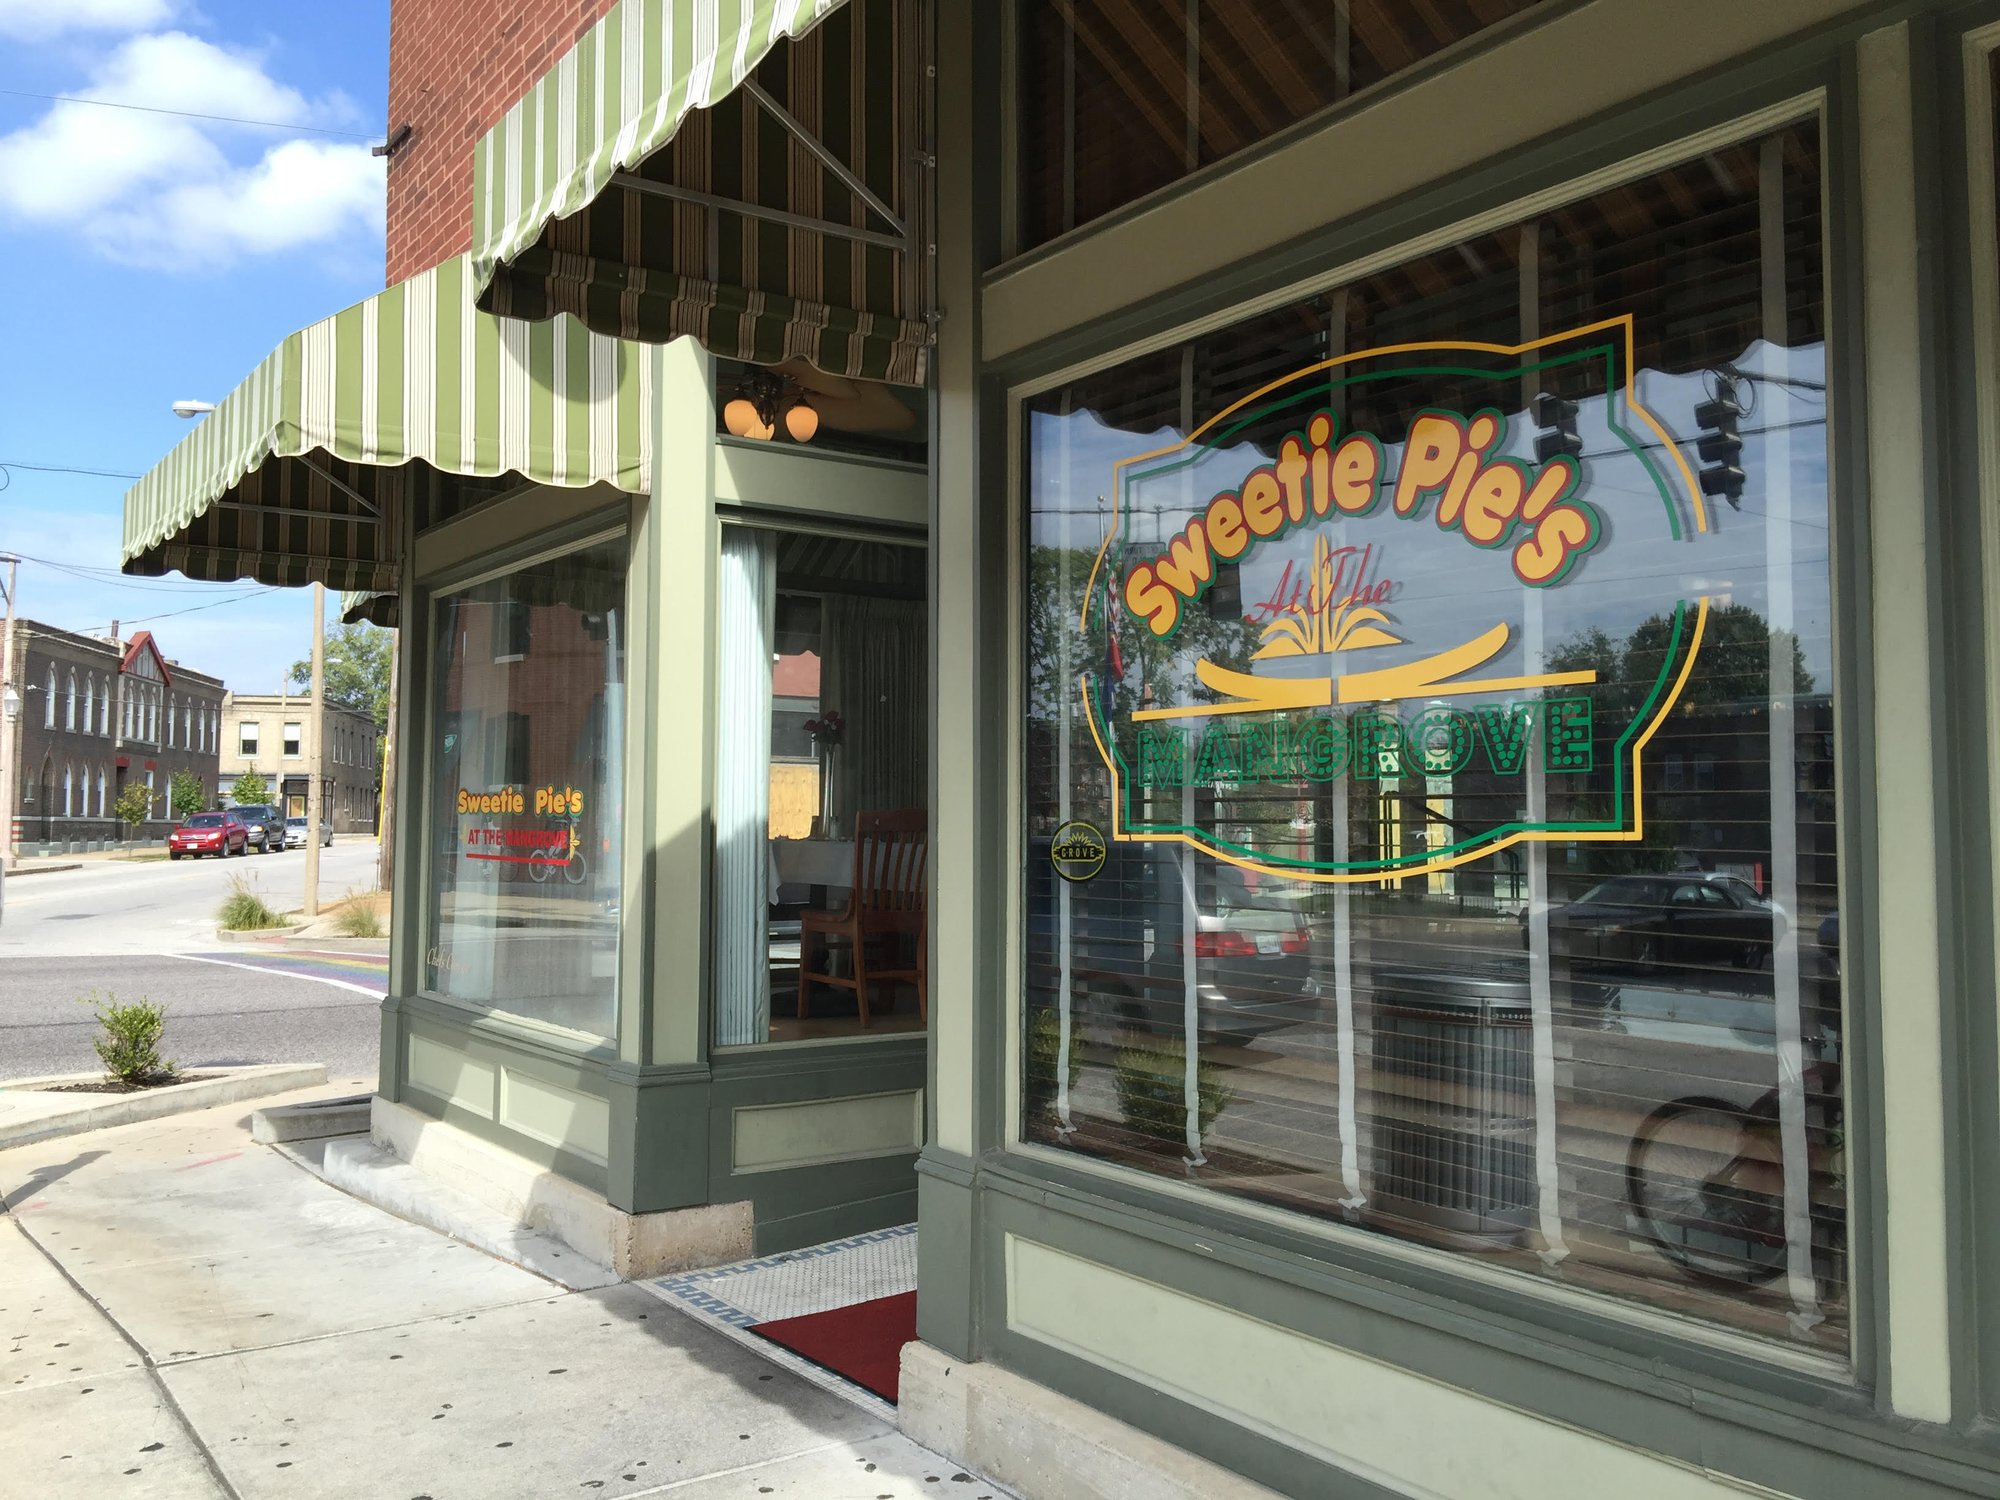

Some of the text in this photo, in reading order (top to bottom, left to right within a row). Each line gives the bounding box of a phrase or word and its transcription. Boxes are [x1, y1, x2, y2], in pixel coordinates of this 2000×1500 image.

[1124, 407, 1601, 640] Sweetie Pie's
[1243, 543, 1391, 625] At The
[1137, 696, 1593, 788] MANGROVE
[457, 784, 584, 816] Sweetie Pie's
[467, 828, 569, 850] AT THE MANGROVE
[1061, 847, 1095, 858] GROVE
